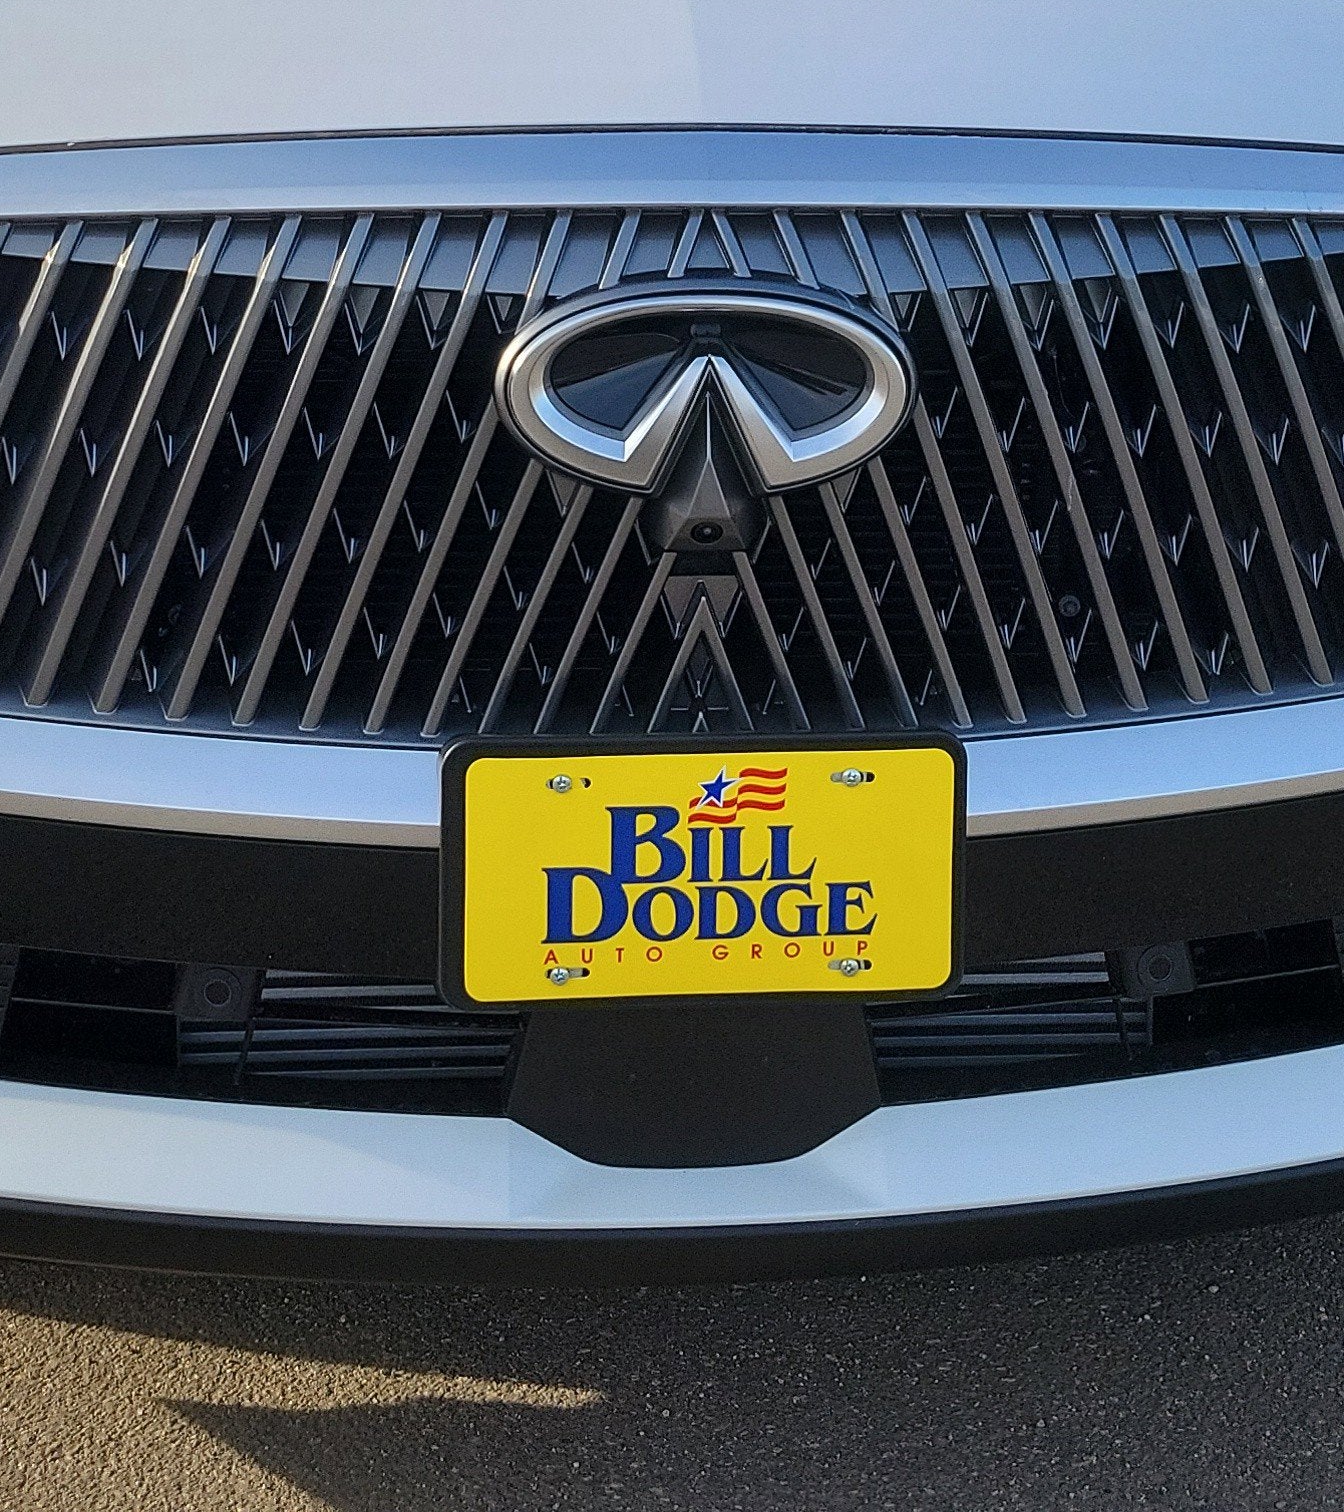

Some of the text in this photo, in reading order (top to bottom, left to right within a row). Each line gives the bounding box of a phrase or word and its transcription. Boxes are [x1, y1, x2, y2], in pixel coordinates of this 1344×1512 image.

[606, 806, 818, 884] BILL
[542, 867, 878, 944] DODGE
[543, 940, 870, 966] AUTO GROUP
